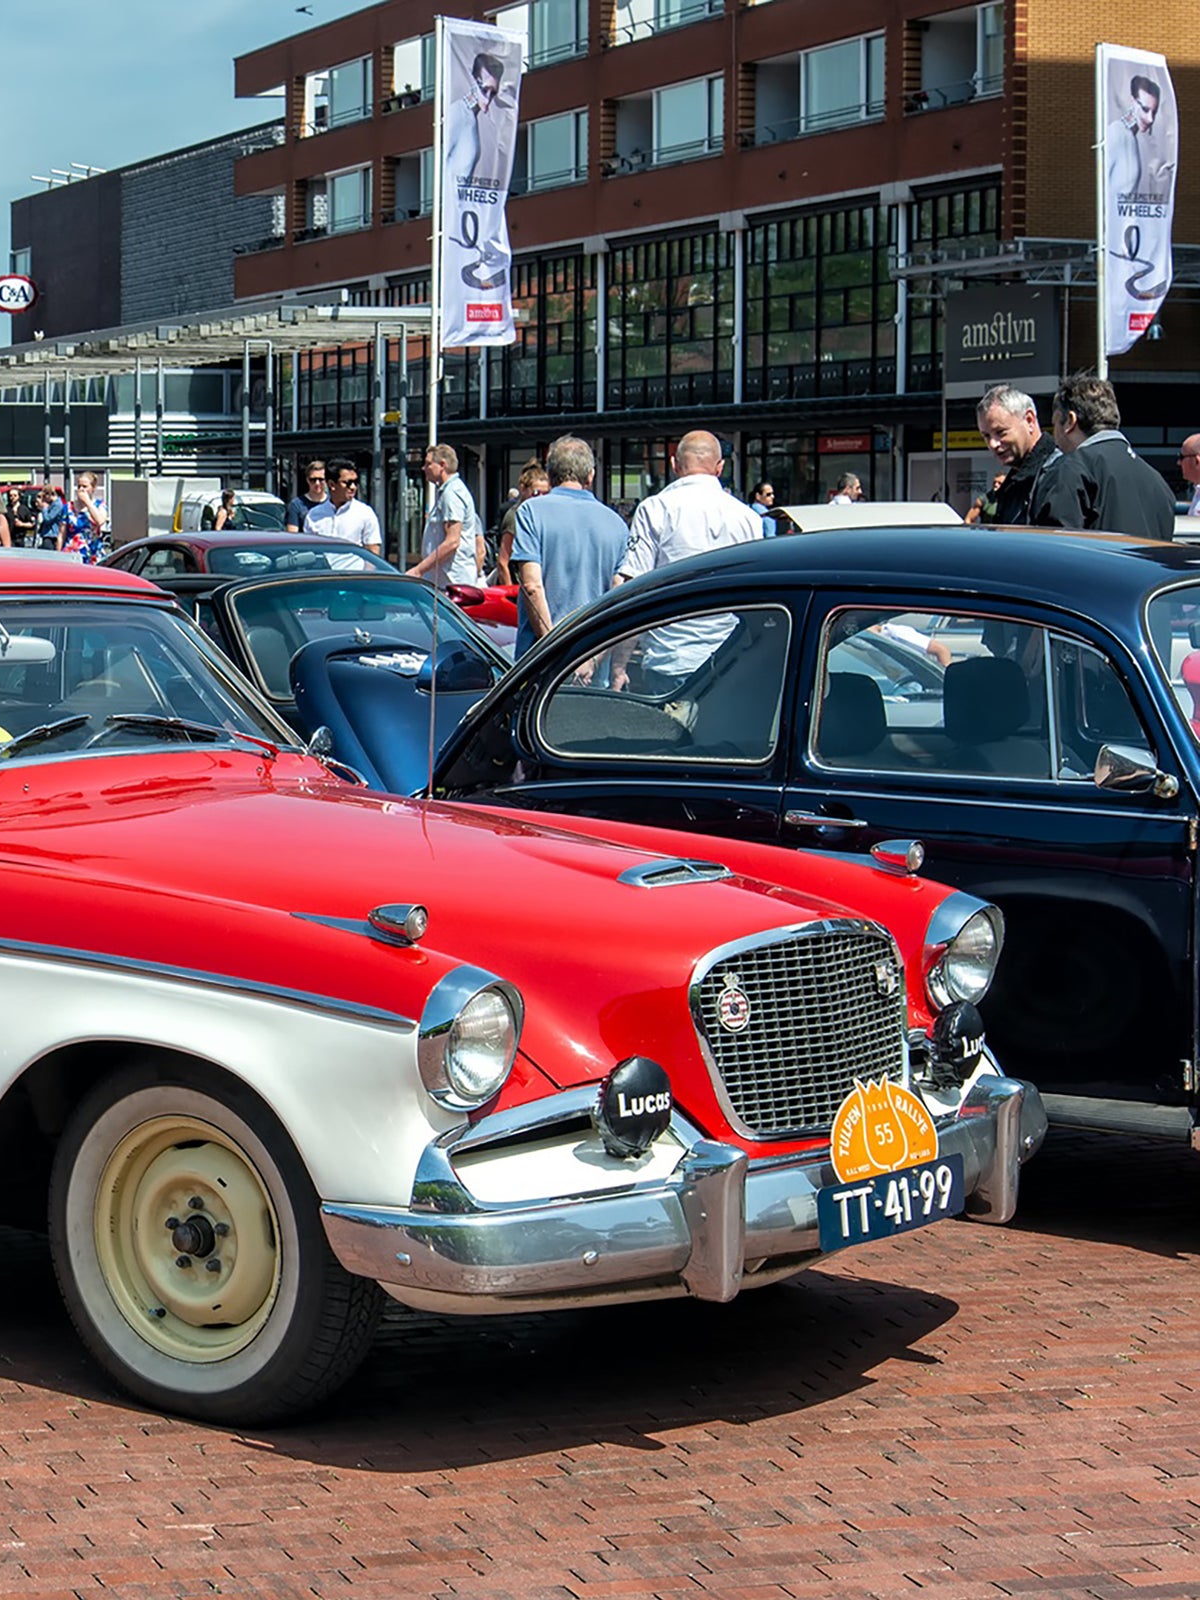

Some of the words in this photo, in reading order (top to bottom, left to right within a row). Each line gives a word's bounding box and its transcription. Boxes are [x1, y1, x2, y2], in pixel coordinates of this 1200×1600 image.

[962, 311, 1036, 348] amstlvn
[618, 1091, 671, 1118] Lucas
[839, 1104, 863, 1158] TULPEN
[895, 1094, 929, 1136] RALLYE
[874, 1122, 894, 1146] 55
[832, 1164, 953, 1238] TT-41-99
